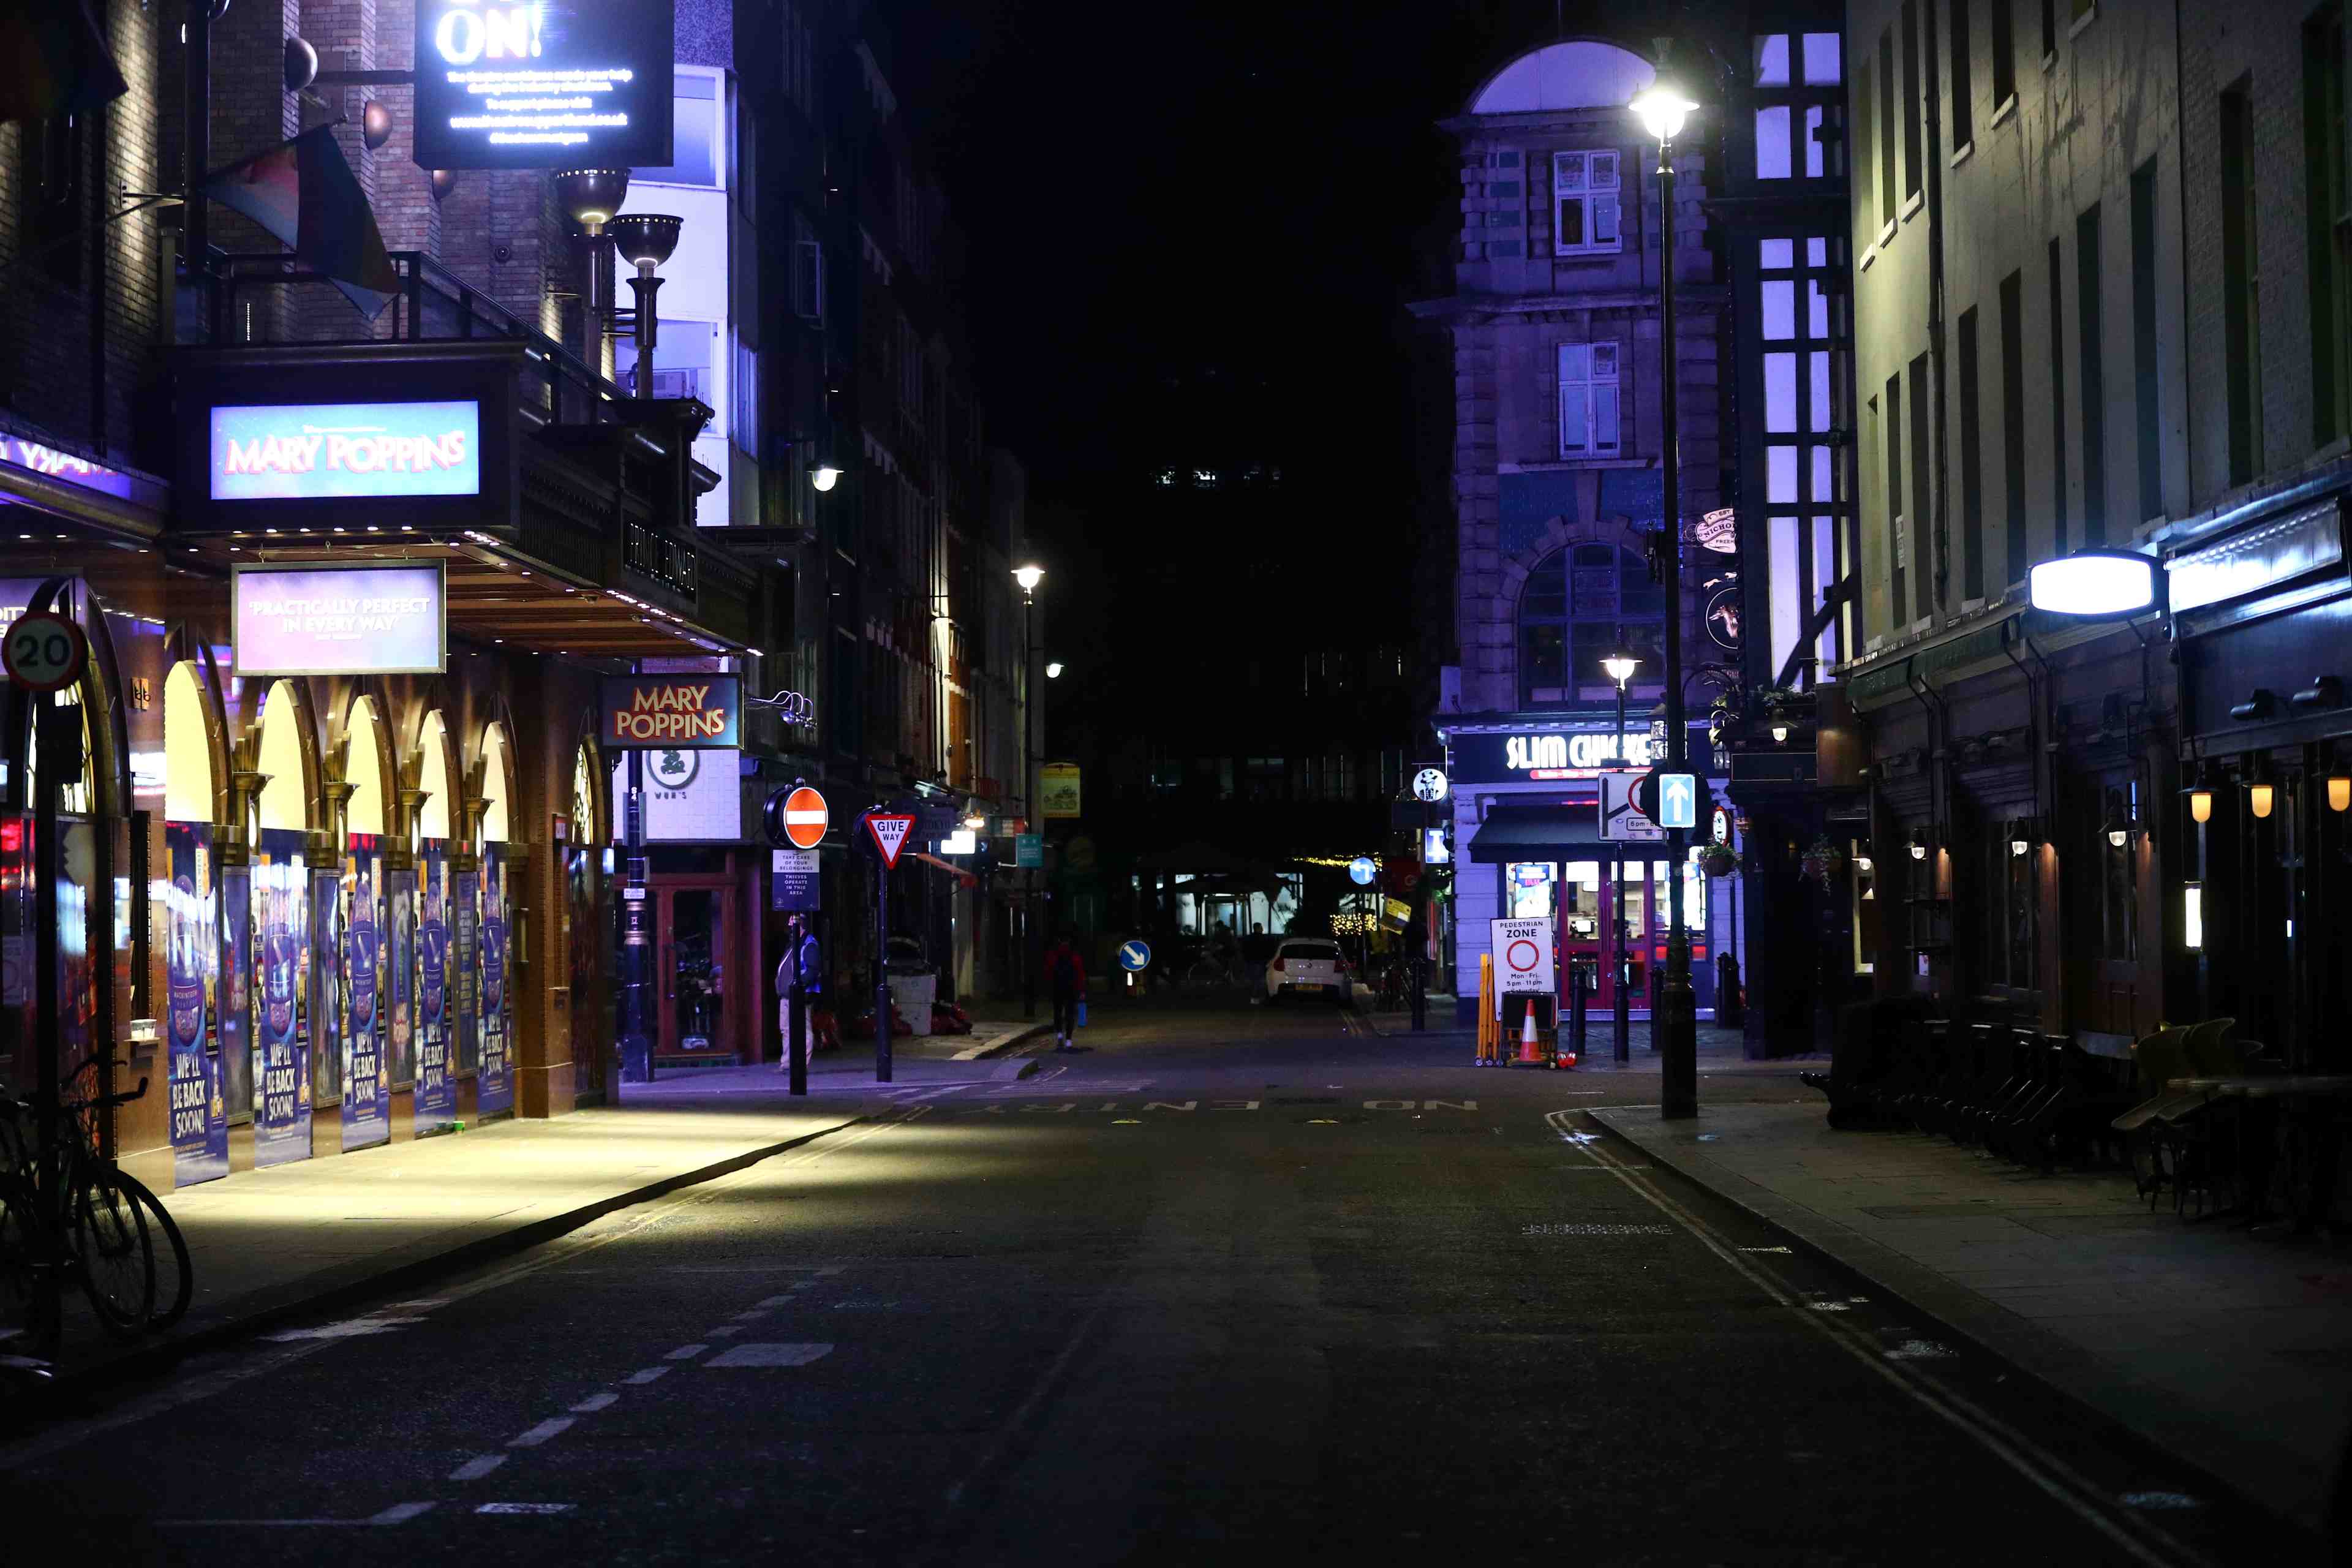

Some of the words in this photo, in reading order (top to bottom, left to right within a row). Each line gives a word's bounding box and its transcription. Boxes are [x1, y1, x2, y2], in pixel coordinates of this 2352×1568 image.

[435, 1, 543, 64] ON!
[224, 434, 324, 474] MARY
[326, 431, 466, 473] POPPINS
[1704, 523, 1734, 537] NICHO
[361, 597, 430, 613] PERFECT
[284, 617, 301, 633] IN
[305, 616, 355, 632] EVERY
[16, 635, 70, 667] 20
[633, 684, 709, 712] MARY
[617, 708, 725, 739] POPPINS
[1507, 736, 1567, 769] SLIM
[877, 821, 905, 831] GIVE
[1506, 929, 1537, 938] ZONE
[270, 1044, 292, 1066] WE'LL
[356, 1032, 372, 1054] WE'LL
[176, 1054, 200, 1079] WE'LL
[354, 1058, 361, 1079] BE
[361, 1055, 376, 1079] BACK
[266, 1072, 275, 1095] BE
[276, 1068, 295, 1093] BACK
[356, 1079, 375, 1104] SOON!
[173, 1084, 183, 1109] BE
[184, 1080, 206, 1108] BACK
[269, 1095, 293, 1121] SOON!
[176, 1109, 205, 1139] SOON!
